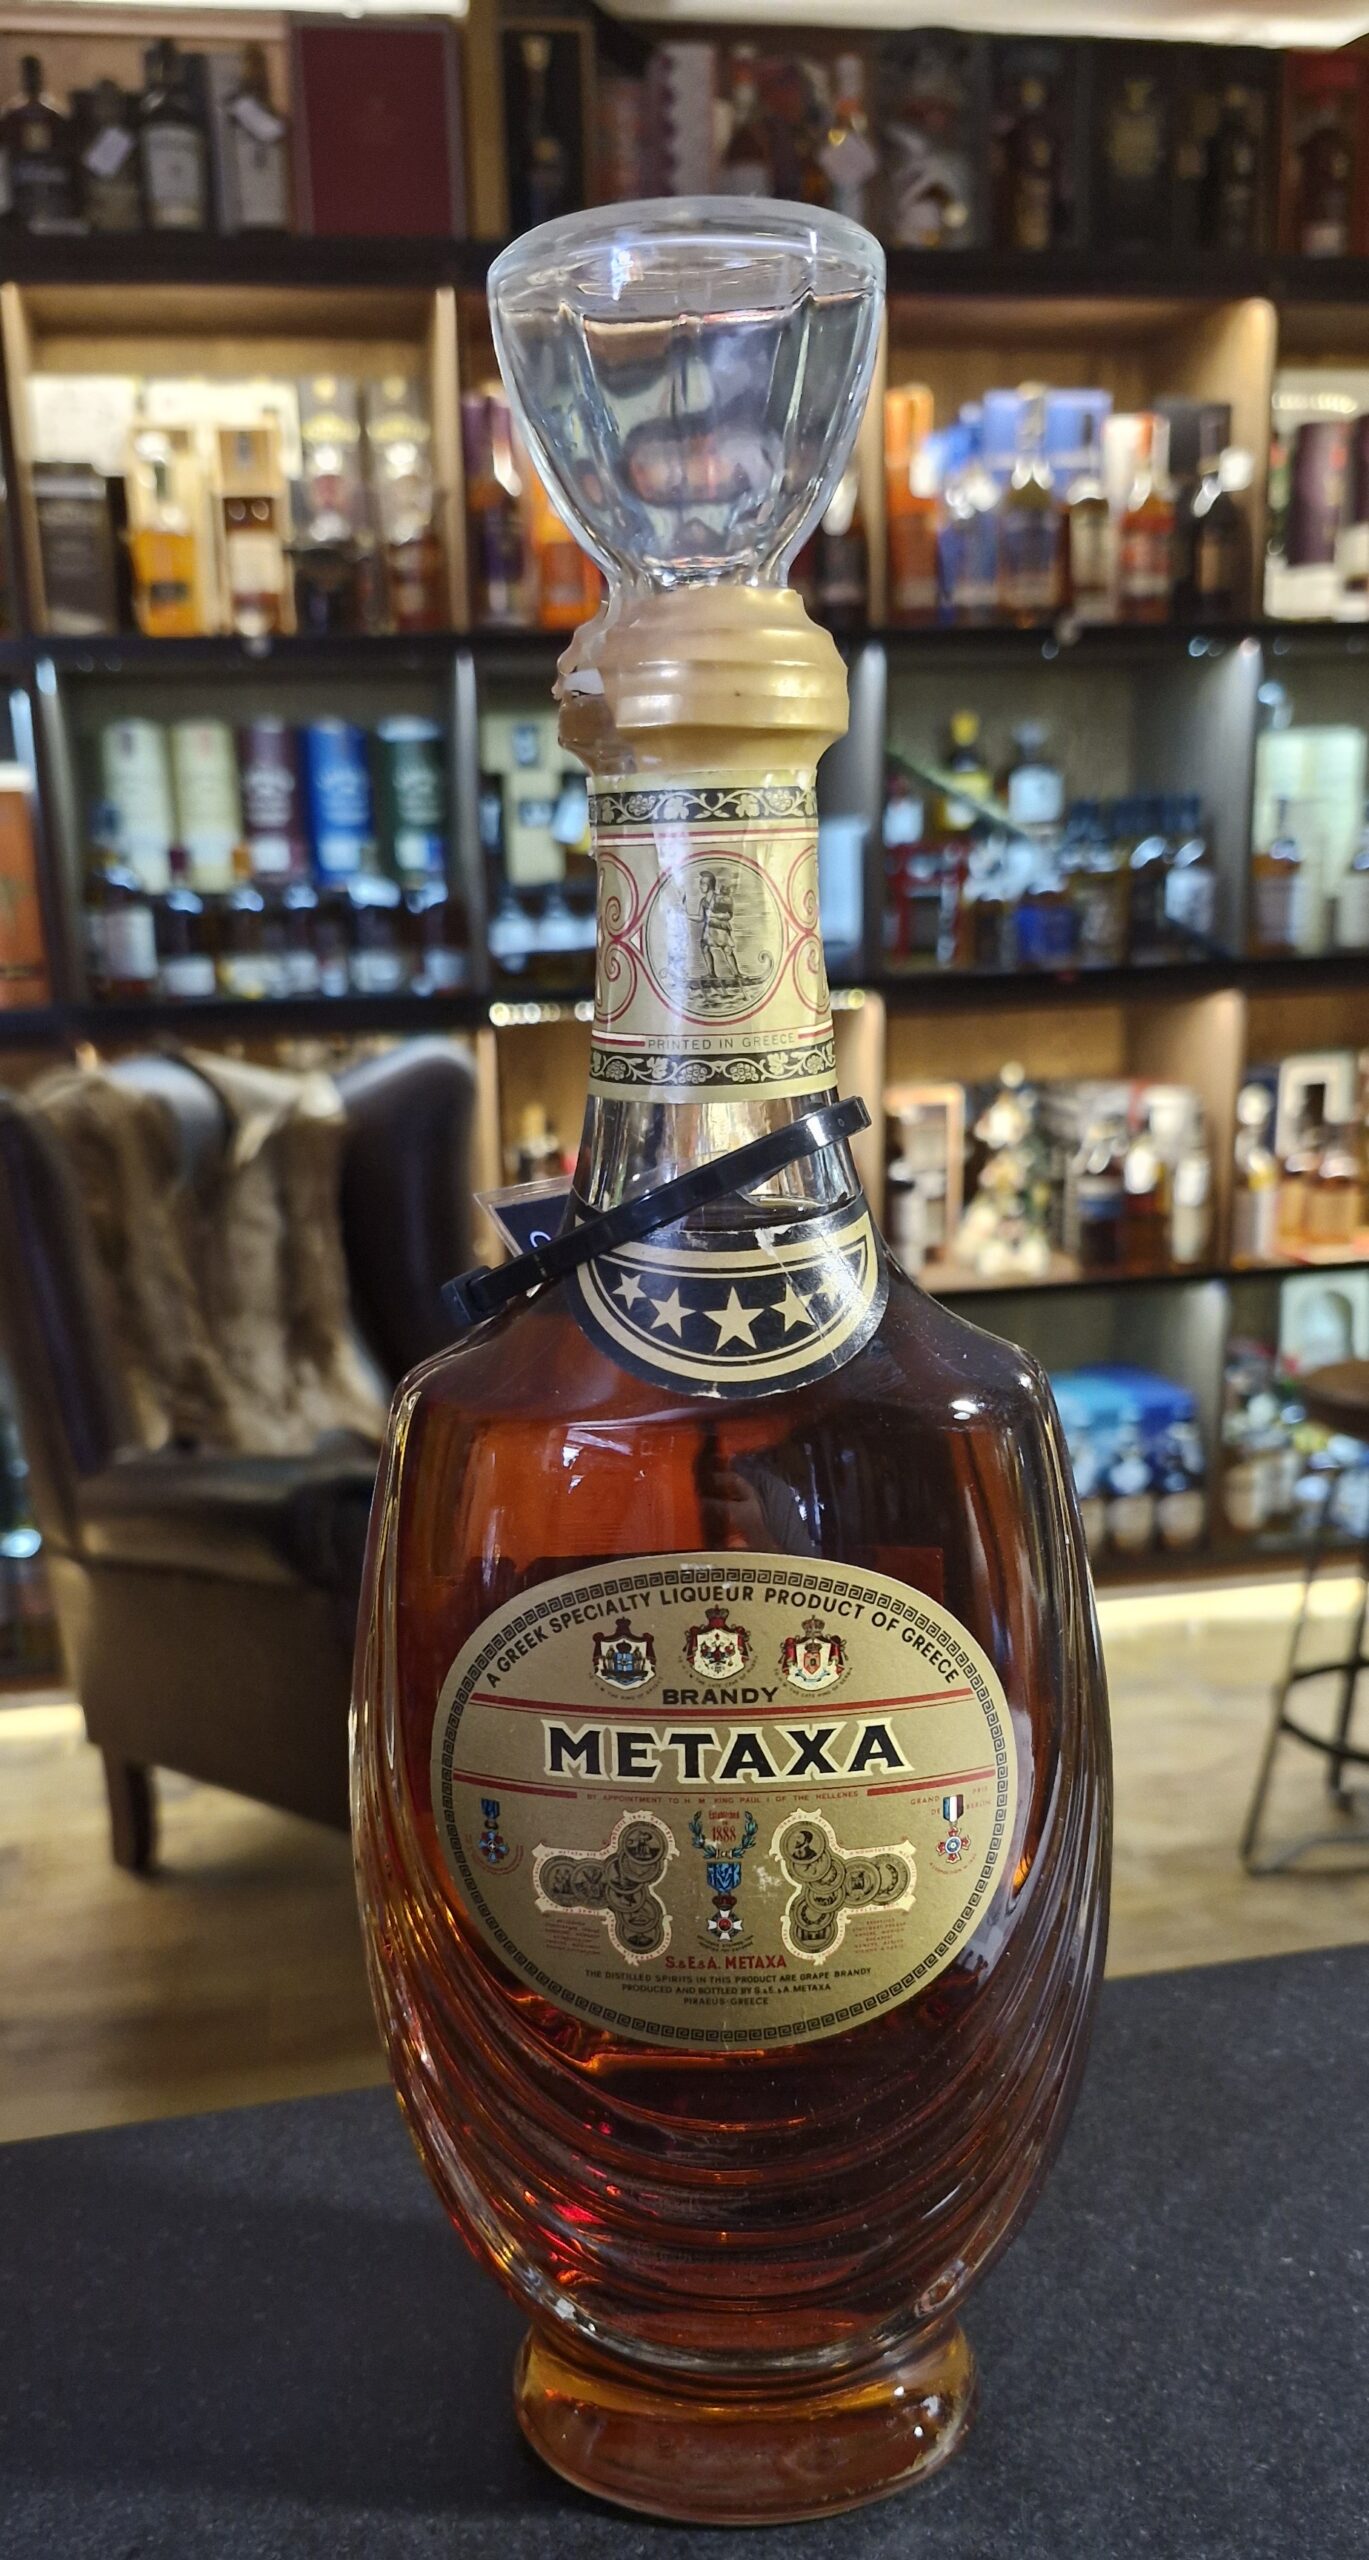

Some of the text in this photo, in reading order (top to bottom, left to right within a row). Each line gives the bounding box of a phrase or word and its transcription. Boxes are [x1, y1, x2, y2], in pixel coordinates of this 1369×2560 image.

[648, 1032, 795, 1051] PRINTED IN GREECE
[486, 1586, 960, 1689] A GREEK SPECIALTY LIQUEUR PRODUCT OF GREECE
[662, 1687, 779, 1705] BRANDY
[543, 1719, 913, 1783] METAXA
[603, 1794, 661, 1804] APPOINTMENT
[740, 1796, 761, 1804] PAUL
[816, 1790, 859, 1800] HELLENES
[910, 1795, 940, 1805] GRAND
[712, 1825, 737, 1843] 1888
[725, 1954, 787, 1970] METAXA
[585, 1967, 872, 1984] THE DISTILLED SPIRITS IN THIS PRODUCT ARE GRAPE BRANDY
[622, 1983, 672, 1994] PRODUCED
[675, 1986, 696, 1995] AND
[698, 1987, 738, 1995] BOTTLED
[741, 1986, 751, 1995] BY
